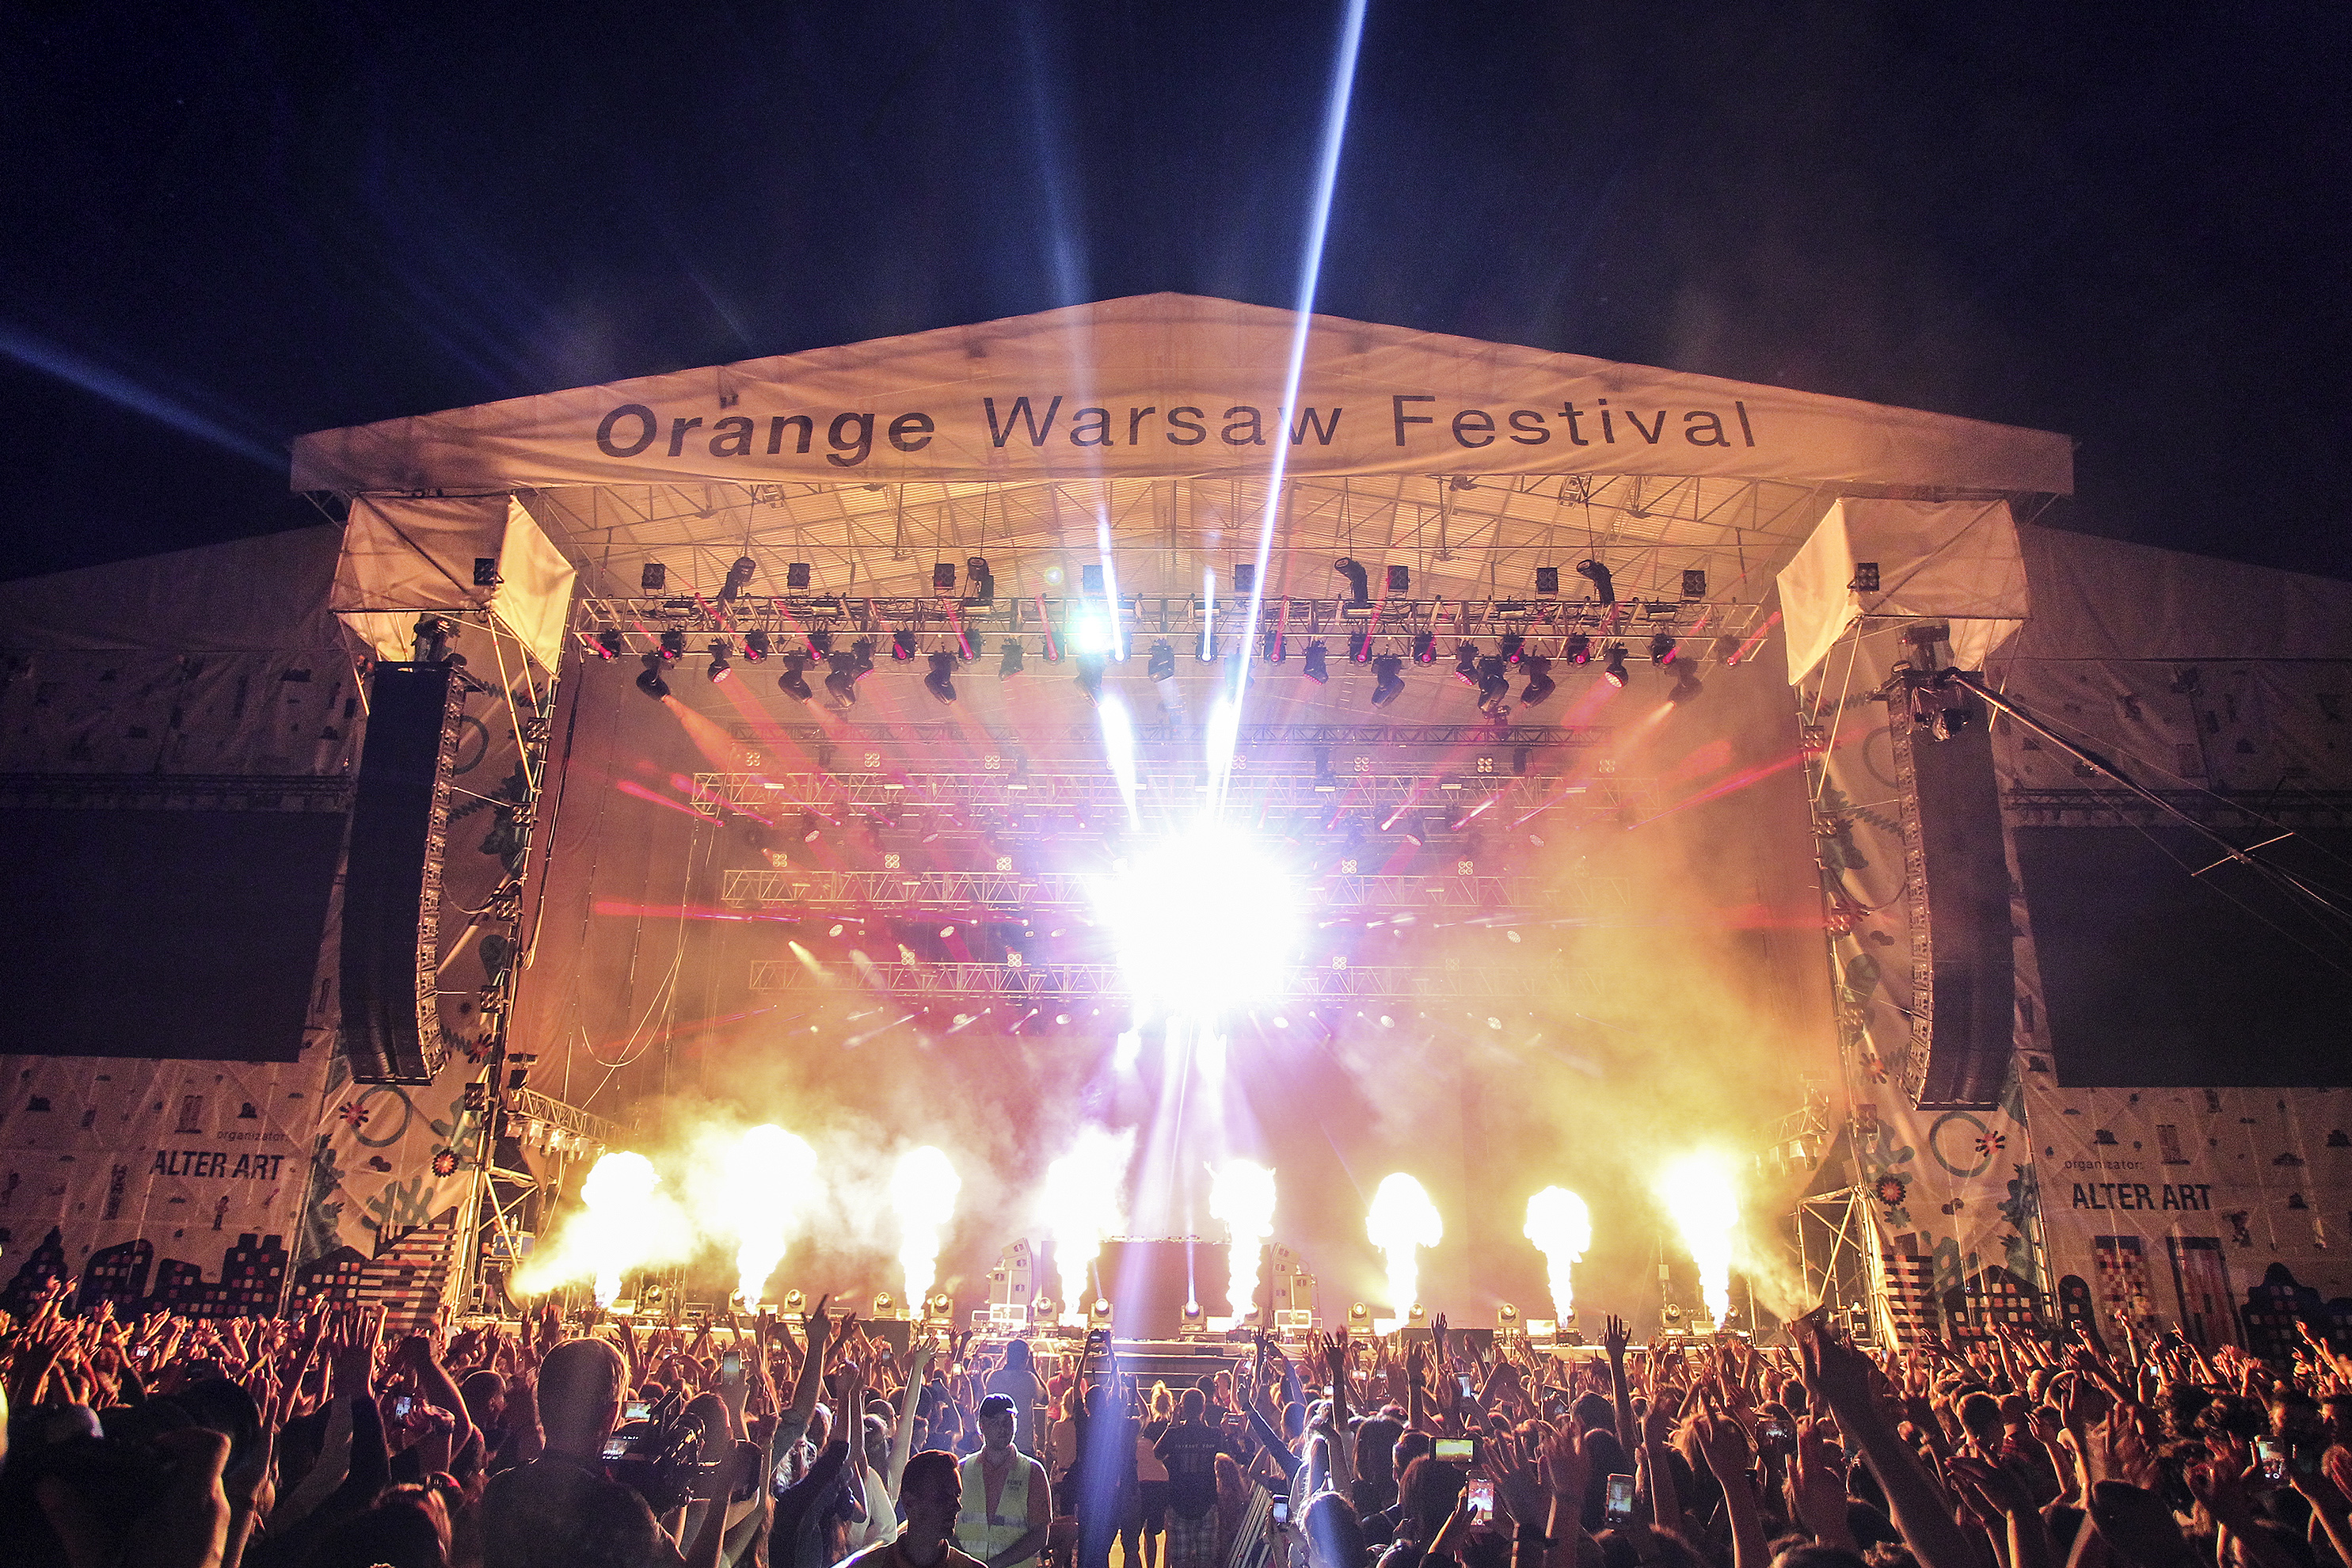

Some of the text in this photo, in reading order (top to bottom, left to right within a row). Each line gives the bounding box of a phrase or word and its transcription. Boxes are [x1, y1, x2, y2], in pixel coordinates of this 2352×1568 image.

[596, 395, 1756, 467] Orange Warsaw Festival
[150, 1150, 284, 1180] ALTER ART
[2072, 1183, 2211, 1211] ALTER ART
